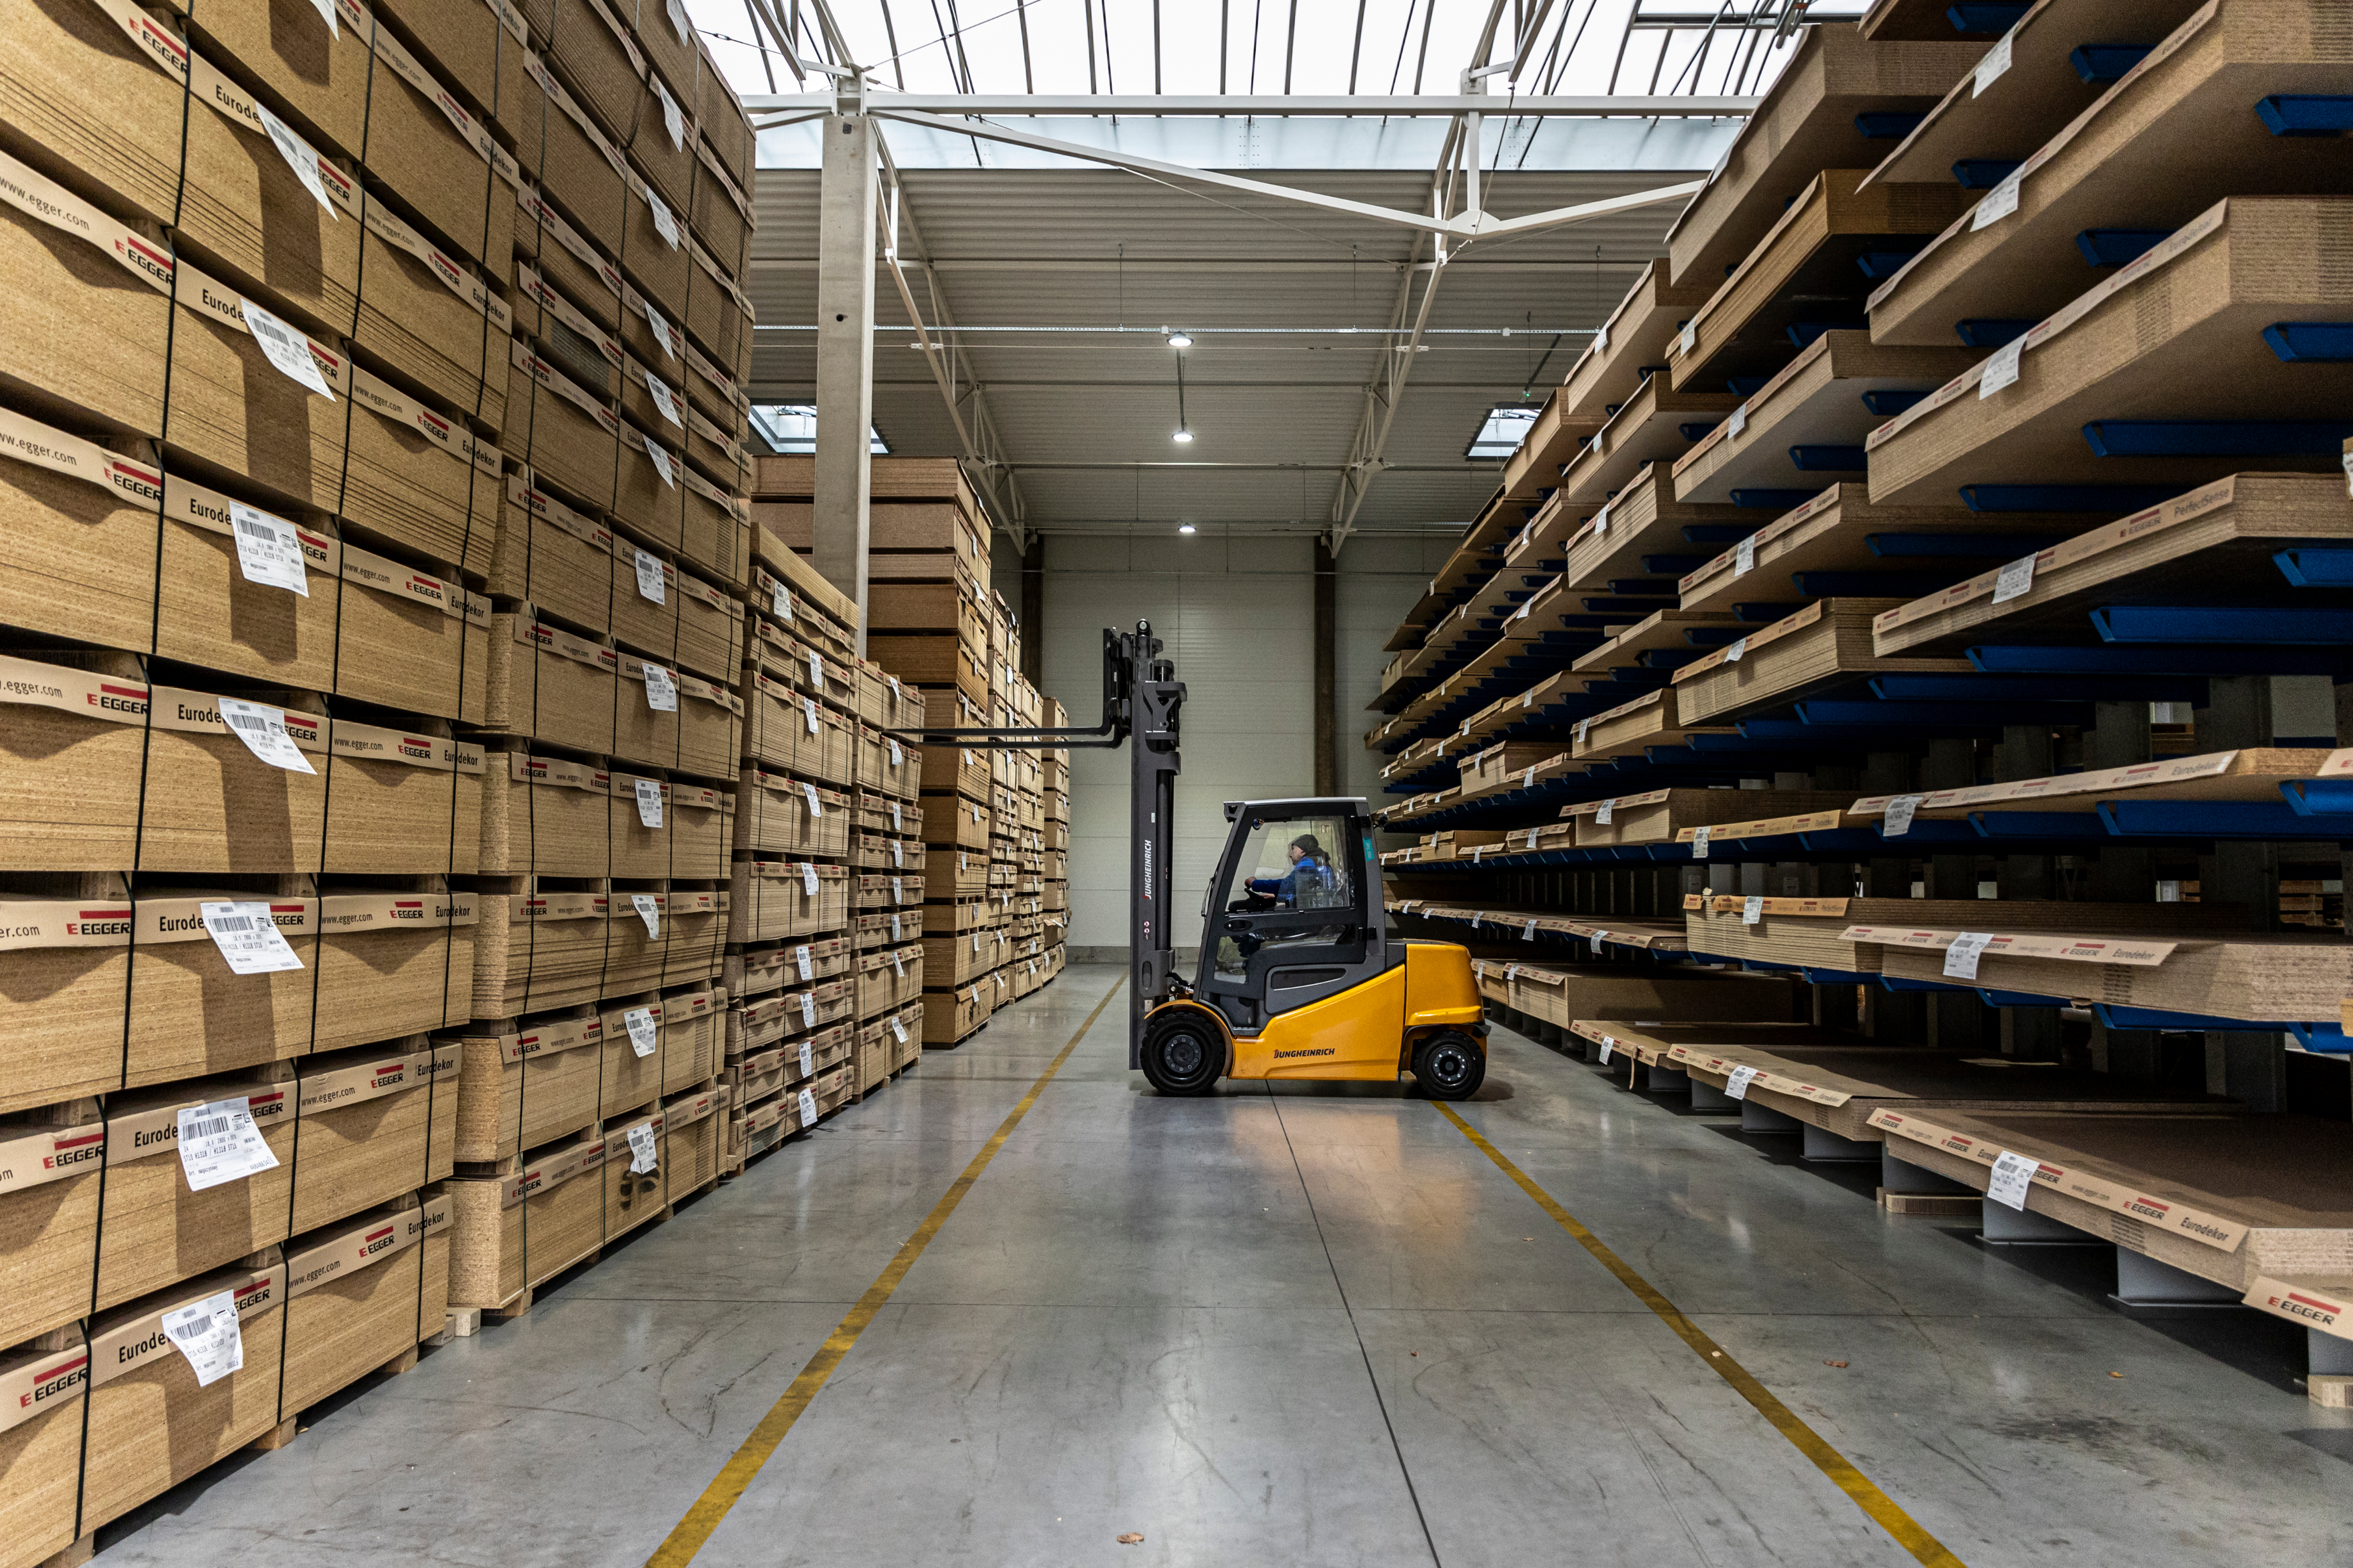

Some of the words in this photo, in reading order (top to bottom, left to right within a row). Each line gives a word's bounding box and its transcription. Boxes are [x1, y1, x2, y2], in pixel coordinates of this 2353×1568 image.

[143, 30, 188, 75] EGGER
[367, 211, 415, 248] www.egger.com
[434, 264, 460, 287] EGGER
[0, 177, 90, 231] www.egger.com
[128, 249, 173, 285] EGGER
[309, 354, 338, 380] GGER
[354, 384, 402, 414] www.egger.com
[423, 420, 448, 442] EGGER
[462, 440, 495, 468] Eurdekor
[524, 496, 546, 513] EGER
[114, 473, 161, 501] EGGER
[344, 563, 391, 584] www.egger.com
[414, 585, 442, 601] EGGER
[101, 697, 149, 715] EGGER
[334, 737, 383, 751] www.egger.com
[404, 747, 431, 759] EGGER
[444, 750, 478, 766] Eurdekor
[525, 767, 547, 778] EGER
[1143, 840, 1151, 899] JUNGHEINRICH
[82, 922, 130, 935] EGGER
[321, 914, 373, 924] www.egger.com
[397, 909, 423, 919] EGGER
[2069, 948, 2099, 957] EGGER
[2113, 948, 2155, 961] Eurodekor
[518, 1042, 541, 1055] EGER
[1274, 1048, 1335, 1059] JUNGHEINRICH
[56, 1146, 105, 1167] EGGER
[301, 1086, 356, 1107] www.egger.com
[377, 1072, 403, 1086] EGGER
[1946, 1140, 1969, 1152] EGGER
[2133, 1202, 2165, 1219] EGGER
[2180, 1217, 2229, 1242] Eurodekor
[34, 1367, 87, 1402] EGGER
[288, 1260, 341, 1288] www.egger.com
[368, 1235, 395, 1254] EGGER
[2281, 1300, 2335, 1326] EGGER
